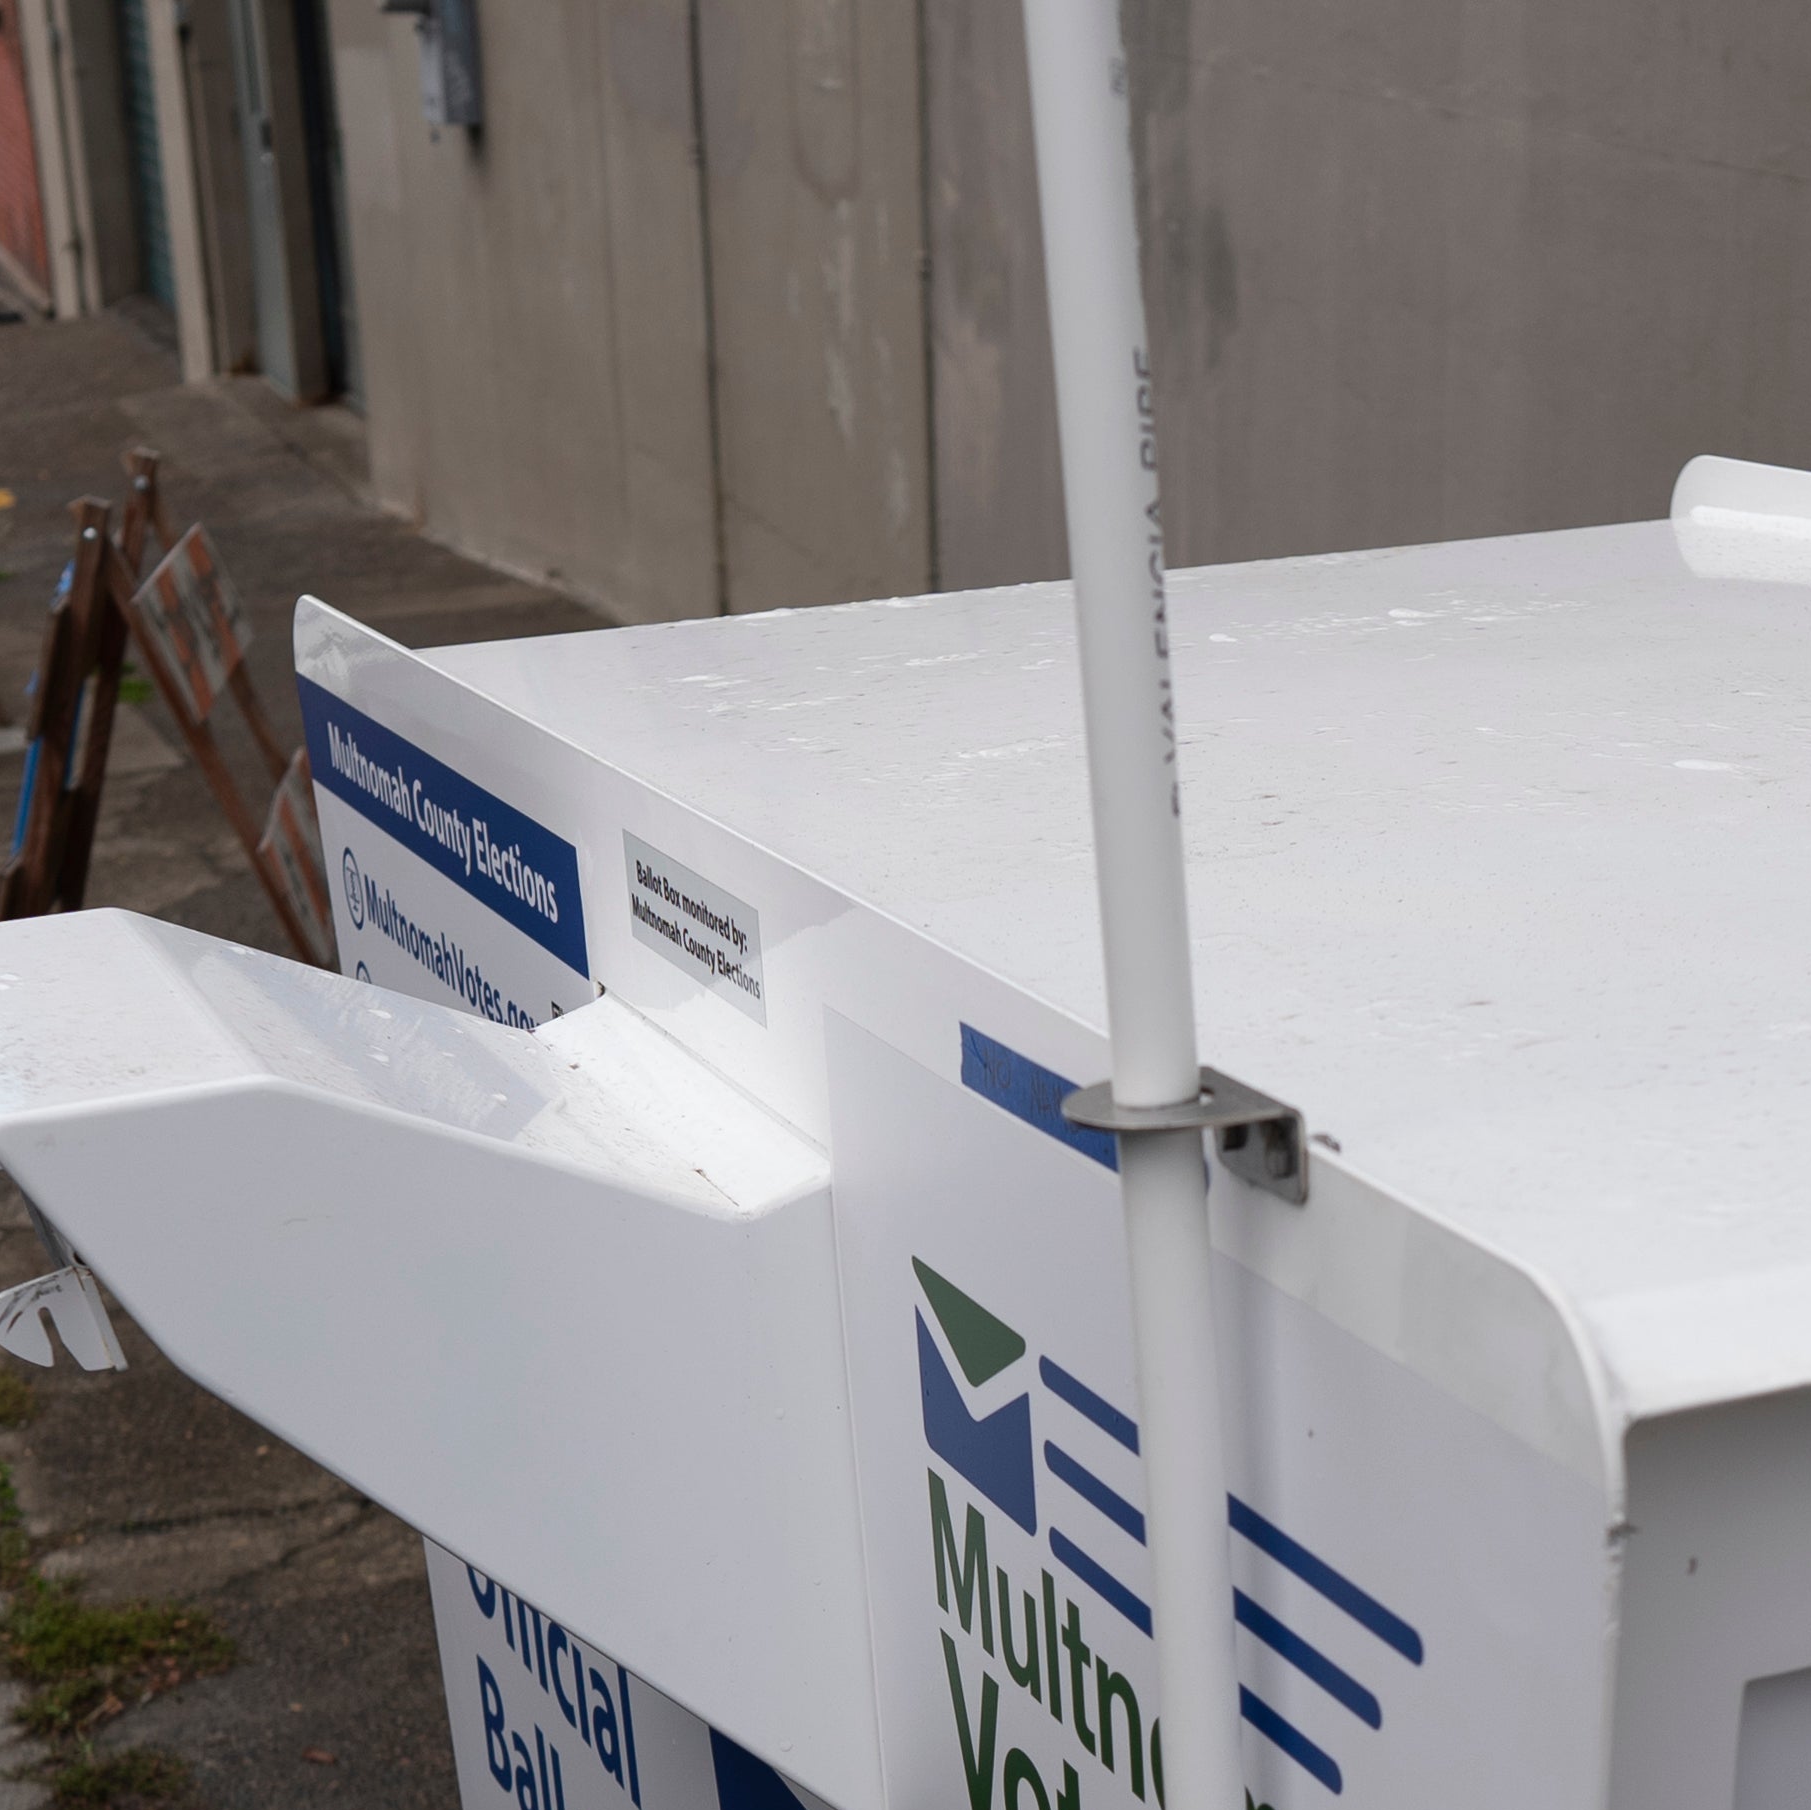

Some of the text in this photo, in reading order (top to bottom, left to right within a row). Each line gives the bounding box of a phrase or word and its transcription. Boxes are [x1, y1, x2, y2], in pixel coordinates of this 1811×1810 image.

[327, 721, 559, 924] Multnomah County Elections
[631, 893, 761, 1000] Multnomah County Elections
[636, 859, 748, 955] Ballot Box monitored by:
